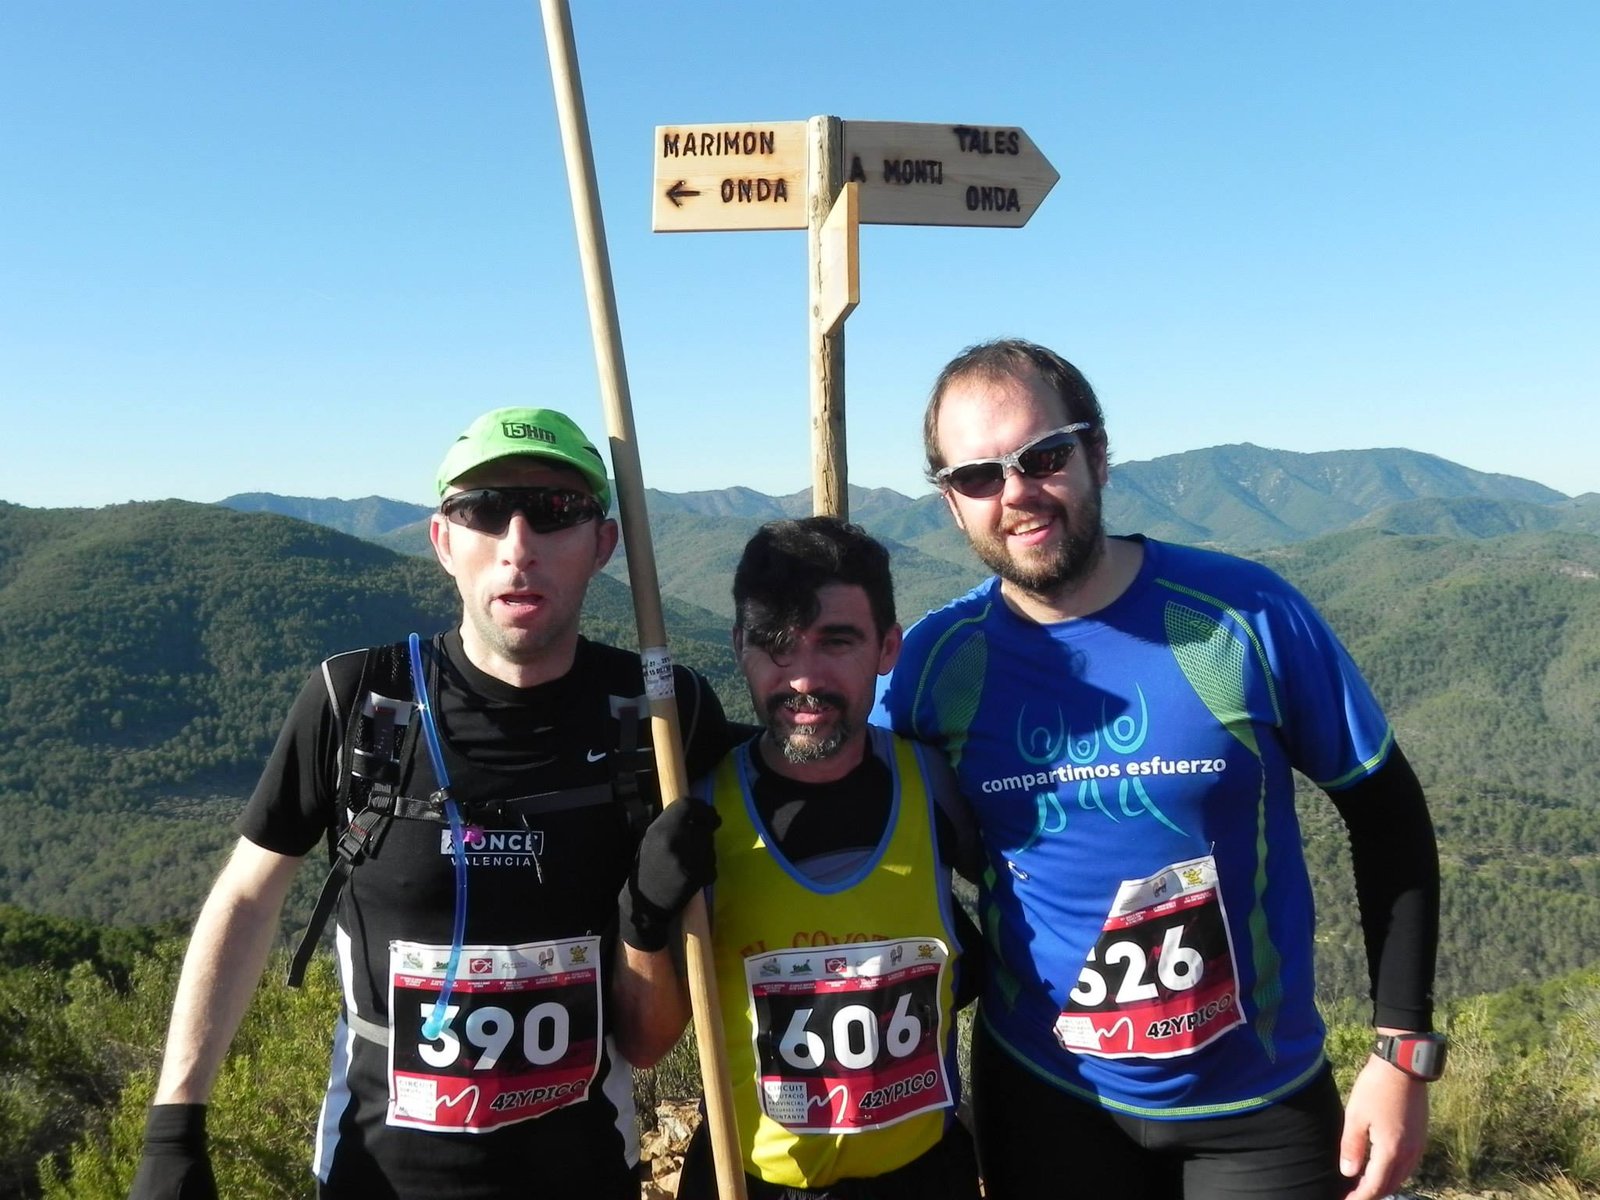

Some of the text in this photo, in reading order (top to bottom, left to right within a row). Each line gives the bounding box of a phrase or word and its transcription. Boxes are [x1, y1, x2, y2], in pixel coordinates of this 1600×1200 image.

[663, 130, 775, 157] MARIMON
[953, 125, 1020, 156] TALES
[849, 156, 866, 183] A
[720, 178, 788, 203] ONDA
[966, 185, 1021, 212] ONDA
[981, 756, 1227, 793] compartimos esfuerzo
[779, 992, 922, 1070] 606
[1146, 991, 1233, 1038] 42YPICO
[417, 1001, 570, 1071] 390
[858, 1069, 937, 1110] 42YPICO
